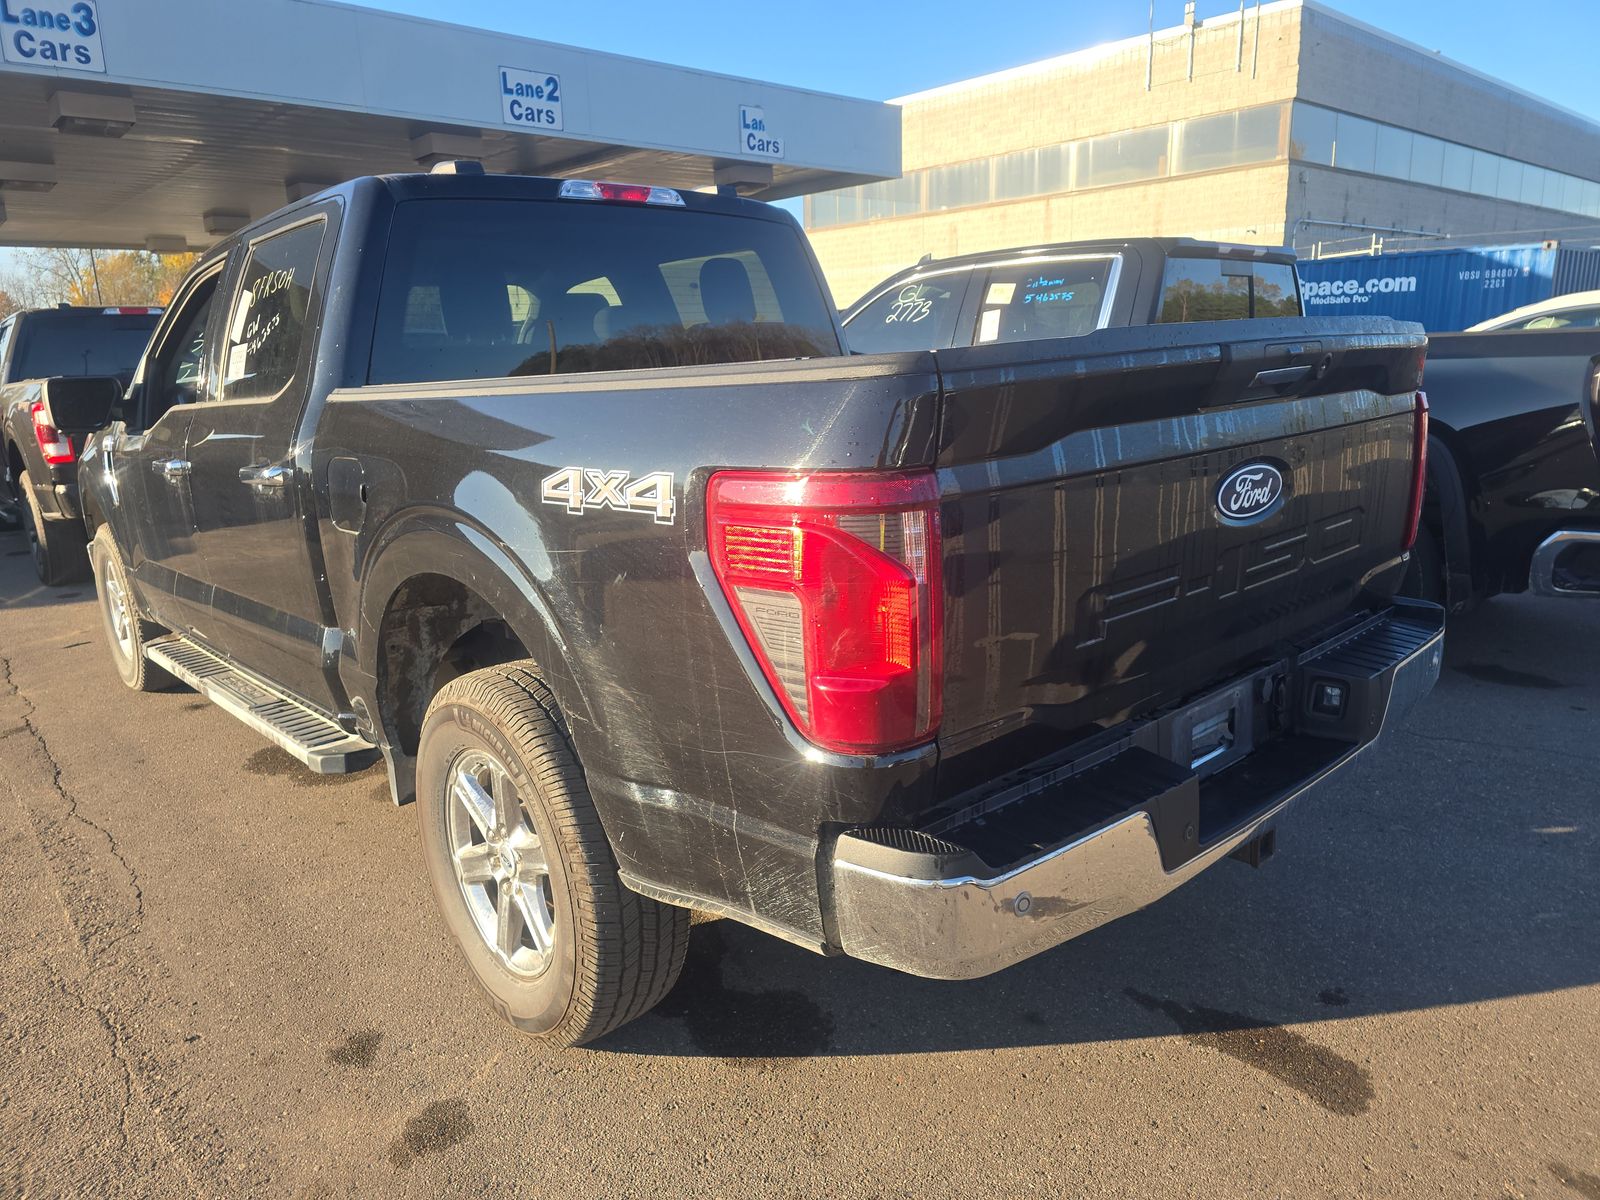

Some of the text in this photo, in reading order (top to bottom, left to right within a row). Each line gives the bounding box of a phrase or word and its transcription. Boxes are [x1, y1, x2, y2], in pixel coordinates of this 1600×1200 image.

[13, 29, 91, 65] Cars
[509, 99, 556, 124] Cars
[746, 132, 780, 153] Cars
[1310, 295, 1352, 305] ModSafe
[885, 301, 932, 323] 2773
[1230, 472, 1273, 511] Ford
[755, 607, 800, 619] FORD
